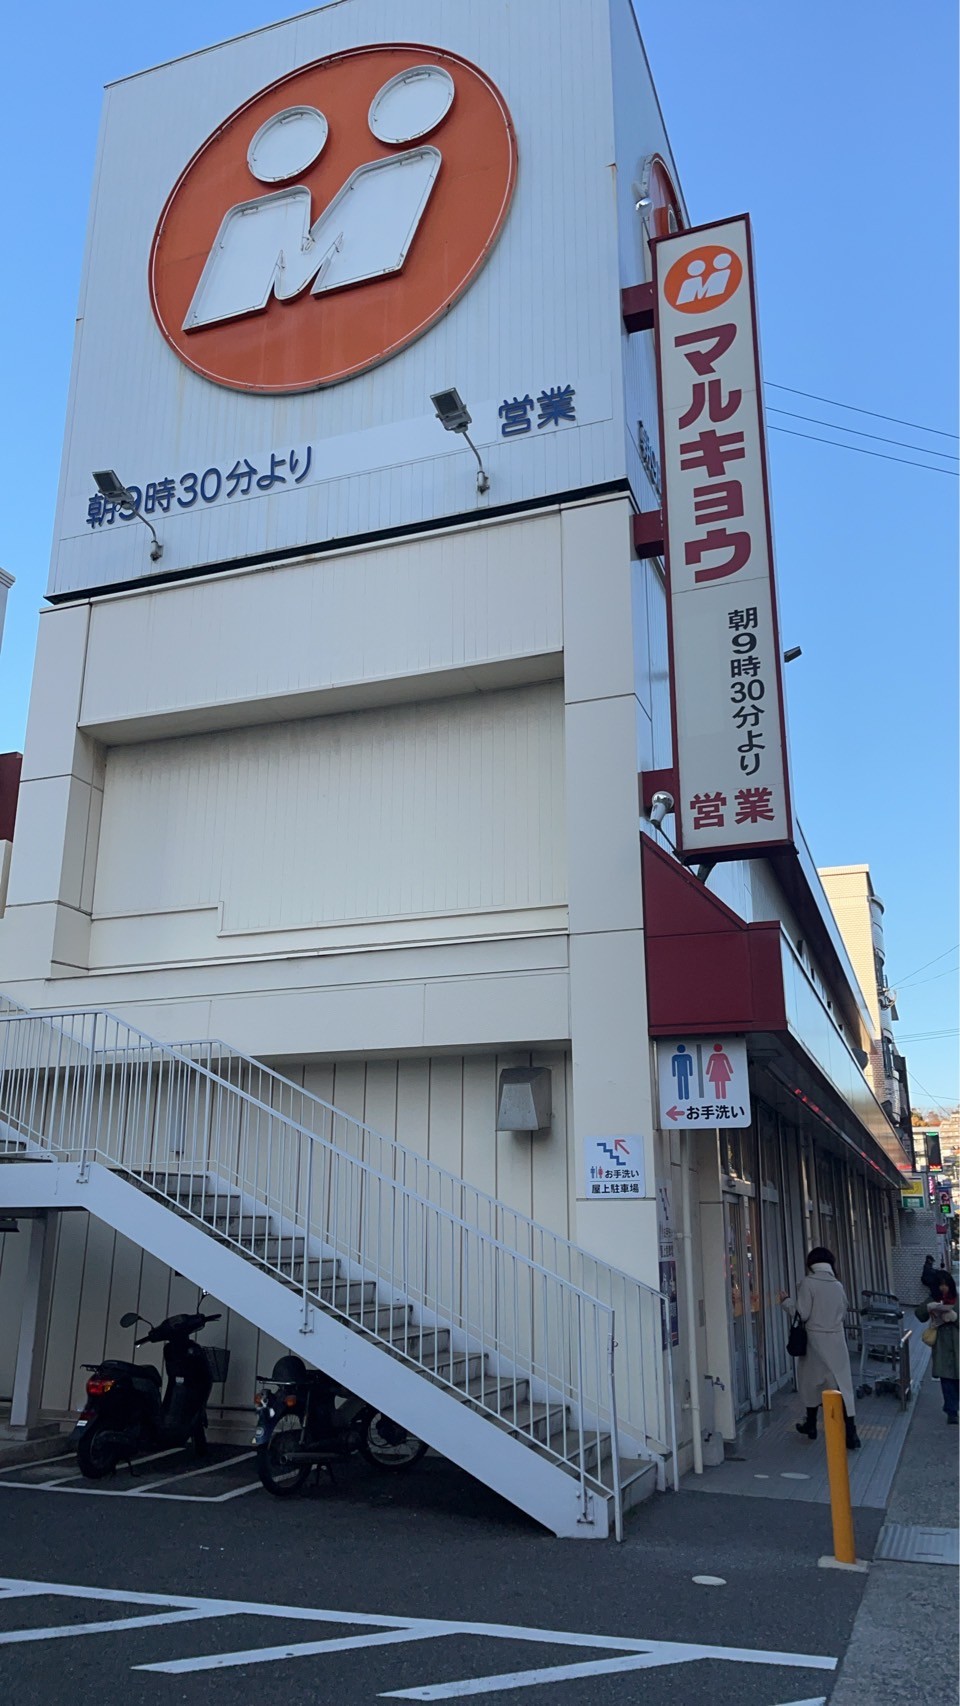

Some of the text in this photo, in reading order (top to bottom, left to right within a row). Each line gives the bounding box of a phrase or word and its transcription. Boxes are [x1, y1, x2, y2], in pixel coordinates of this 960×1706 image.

[86, 383, 577, 529] 朝9時30分より 営業
[674, 323, 751, 583] マルキョウ
[727, 606, 765, 776] 朝9時30分より
[690, 786, 775, 830] 営業
[686, 1104, 745, 1120] お手洗い
[591, 1183, 640, 1194] 屋上駐車場
[604, 1169, 640, 1179] お手洗い
